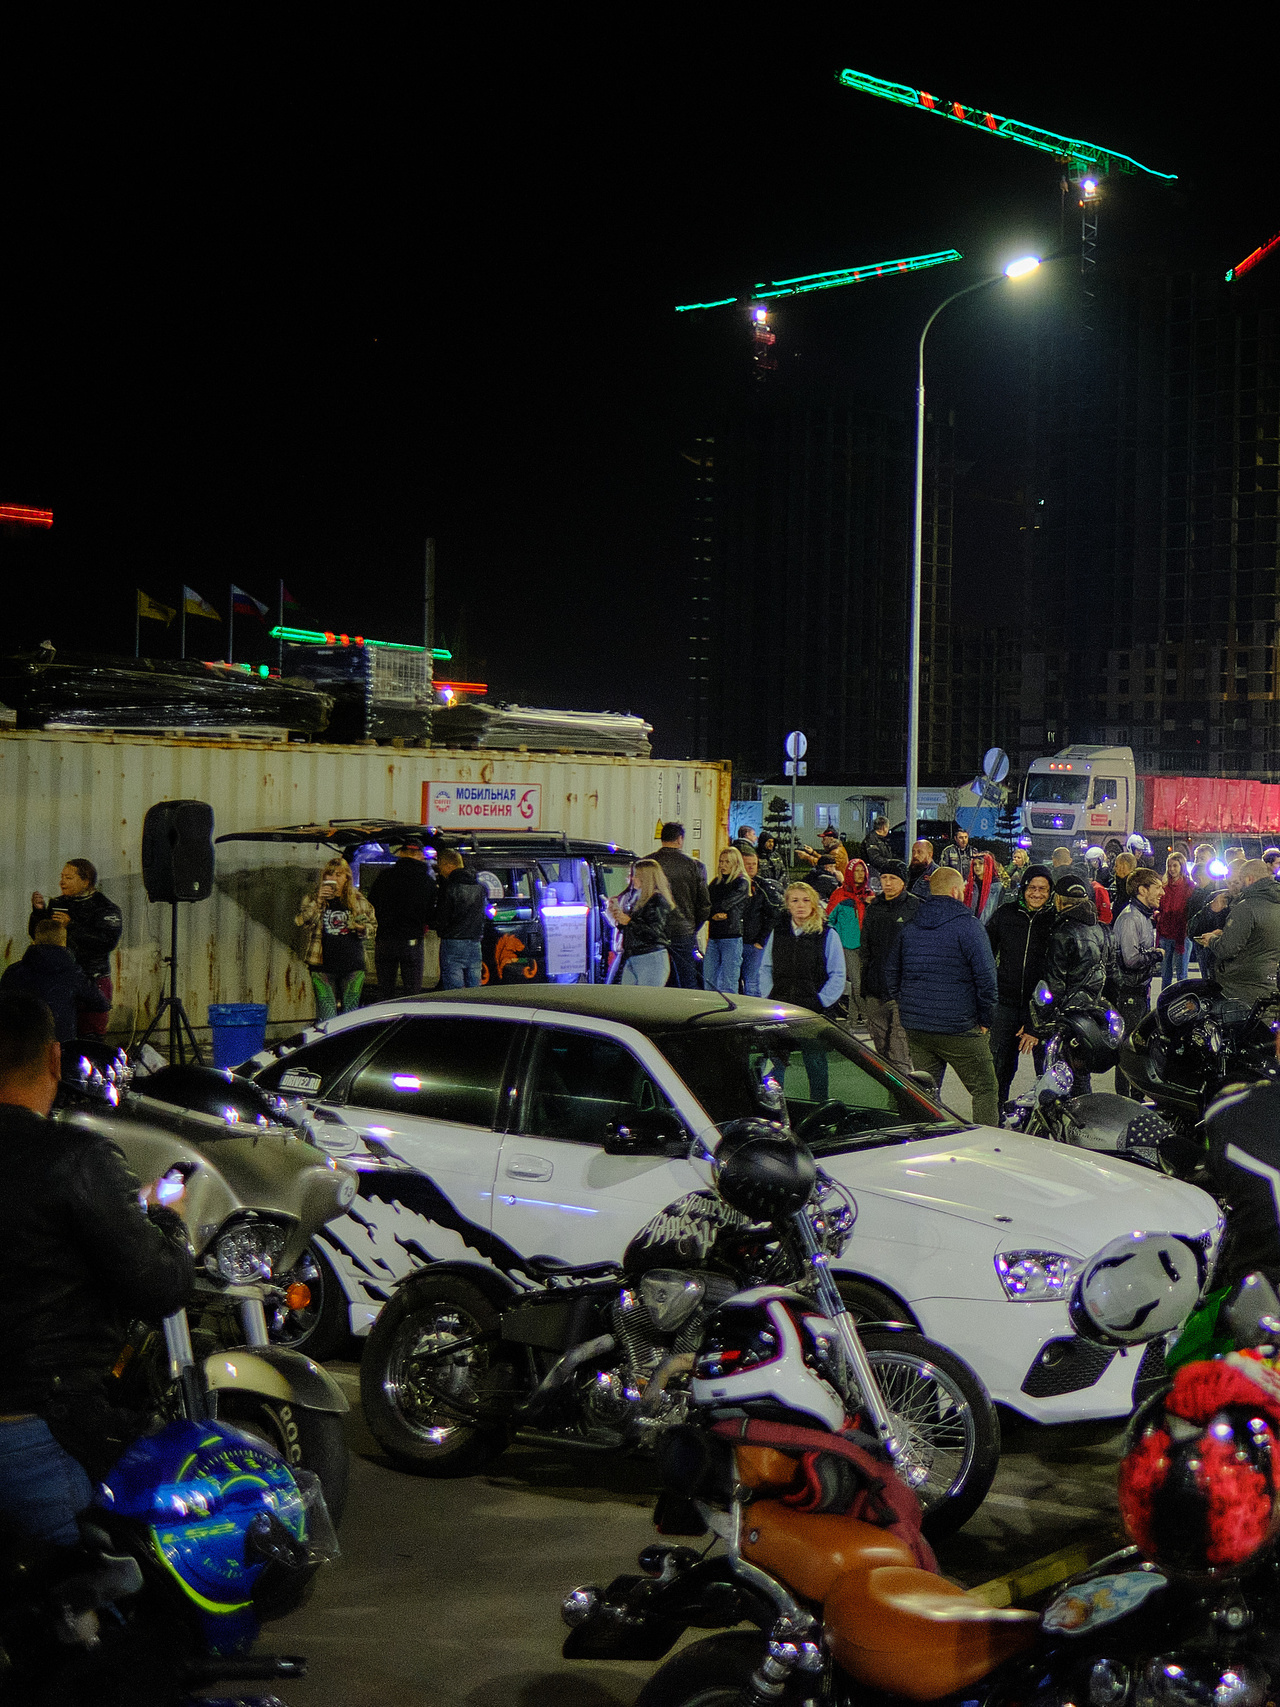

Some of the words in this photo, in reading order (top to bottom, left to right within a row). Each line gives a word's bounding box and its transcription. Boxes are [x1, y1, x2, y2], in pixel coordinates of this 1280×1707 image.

[456, 787, 516, 800] МОБИЛЬНАЯ
[458, 801, 512, 816] КОФЕЙНЯ
[282, 1075, 321, 1090] DRIVE2.RU
